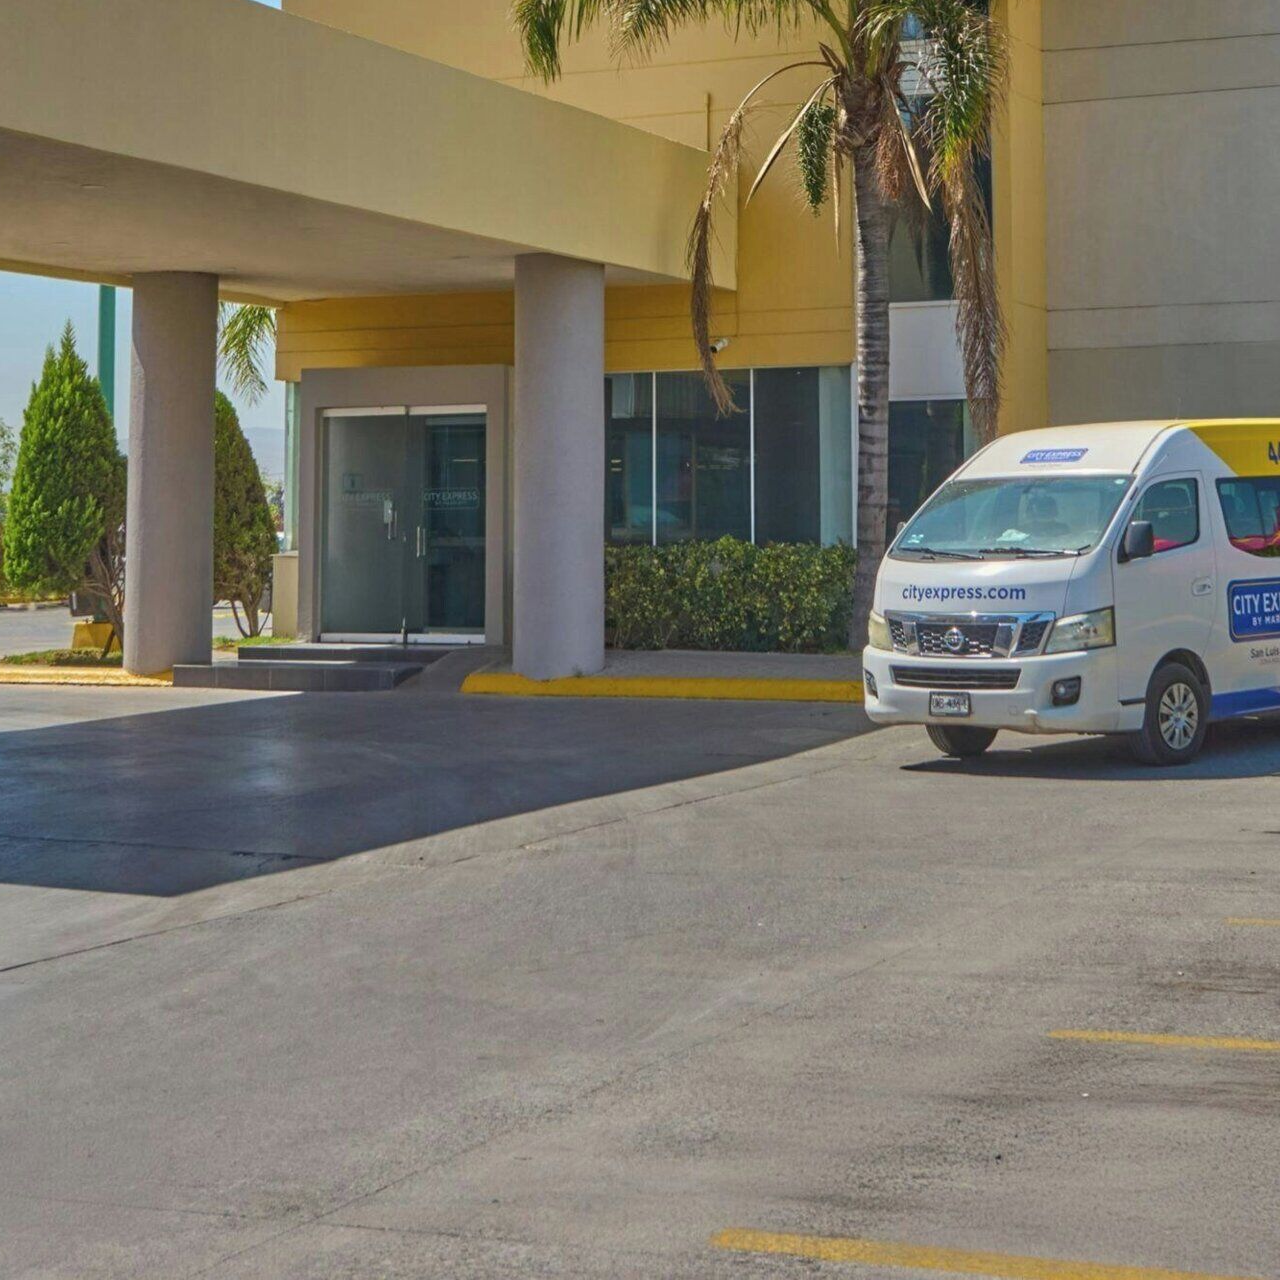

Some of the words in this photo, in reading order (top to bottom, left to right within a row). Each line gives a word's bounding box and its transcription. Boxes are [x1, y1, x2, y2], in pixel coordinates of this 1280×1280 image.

[902, 584, 1026, 602] cityexpress.com
[1233, 593, 1260, 615] CITY
[1251, 615, 1262, 626] BY
[1250, 647, 1264, 659] San
[1265, 646, 1280, 657] Luis
